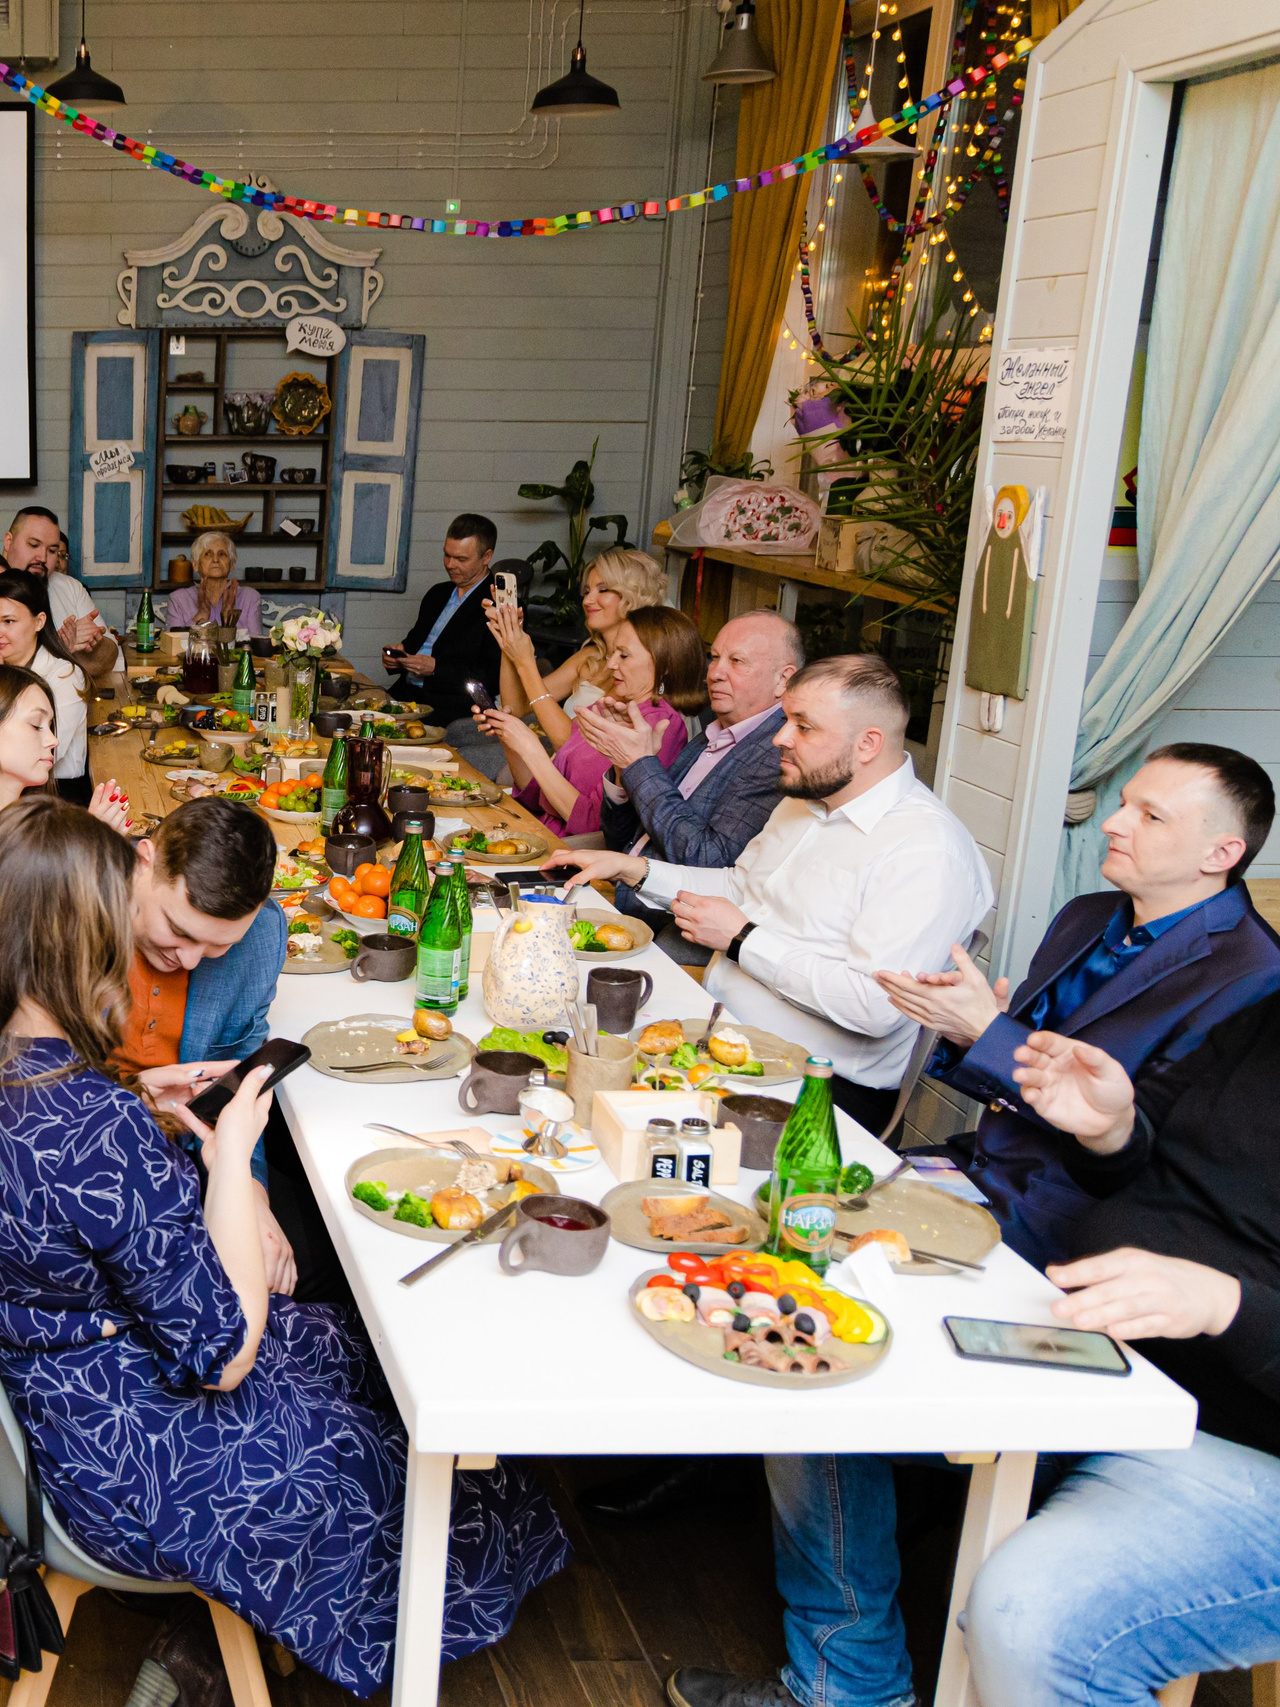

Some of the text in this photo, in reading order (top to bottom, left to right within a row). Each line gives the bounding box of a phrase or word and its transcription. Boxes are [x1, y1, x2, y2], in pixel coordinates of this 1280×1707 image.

[1001, 355, 1069, 381] Желанный
[1020, 381, 1056, 396] ангел
[94, 447, 120, 466] Мы
[389, 919, 418, 932] АРЗАН
[655, 1157, 673, 1178] PEPP
[781, 1208, 835, 1230] НАРЗА
